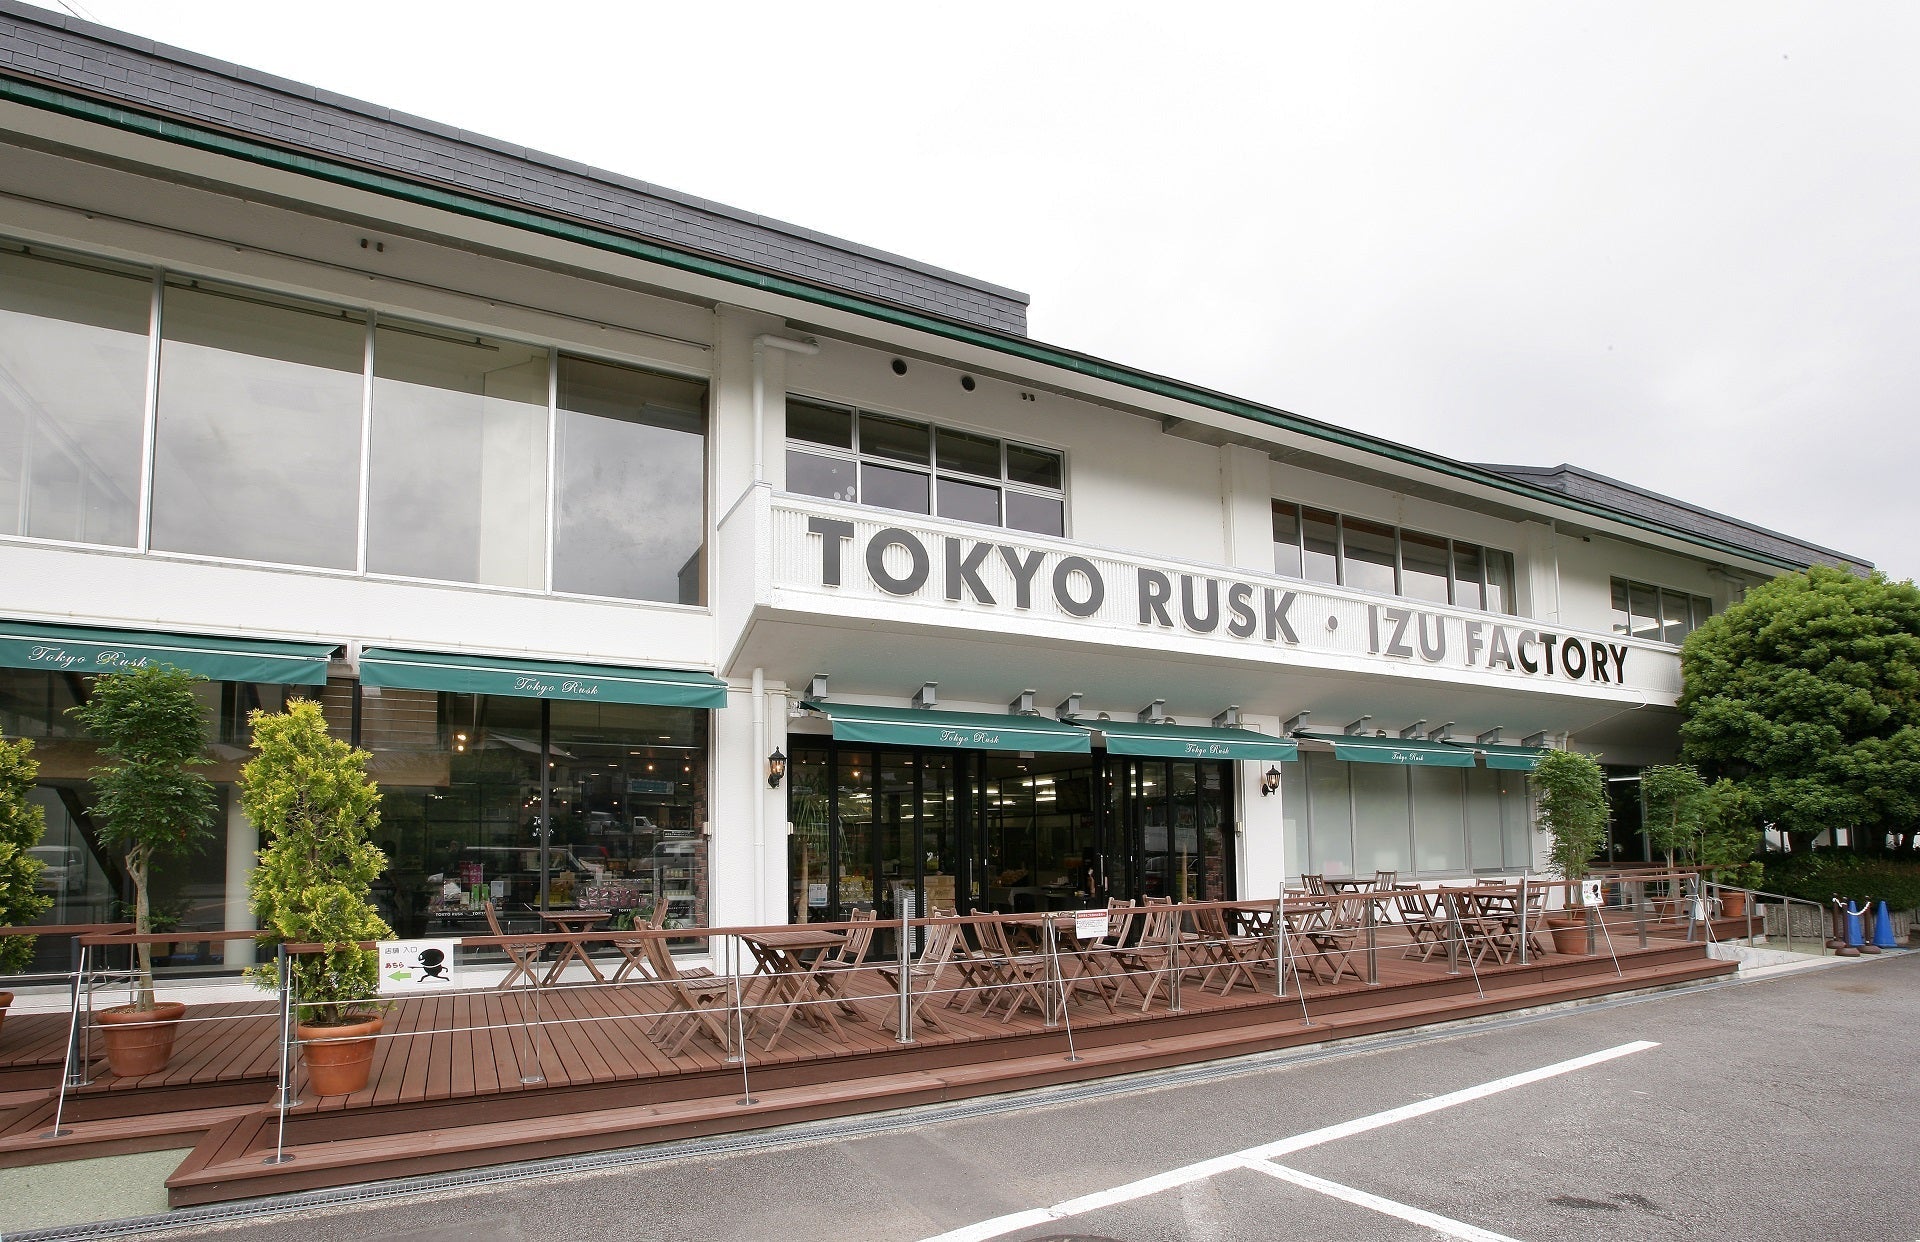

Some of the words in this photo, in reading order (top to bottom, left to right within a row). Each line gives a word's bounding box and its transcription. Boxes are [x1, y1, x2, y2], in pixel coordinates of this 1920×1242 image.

[807, 516, 1105, 618] TOKYO
[1136, 567, 1300, 644] RUSK
[1367, 604, 1447, 663] IZU
[1464, 620, 1628, 685] FACTORY
[28, 645, 87, 669] Tokyo
[95, 650, 148, 668] Rusk
[514, 676, 555, 696] Tokyo
[561, 680, 599, 695] Rusk
[940, 729, 969, 746] Tokyo
[973, 731, 1000, 744] Rusk
[1184, 742, 1207, 757] Tokyo
[1209, 743, 1230, 754] Rusk
[402, 946, 418, 954] 入口
[384, 961, 405, 969] あちら
